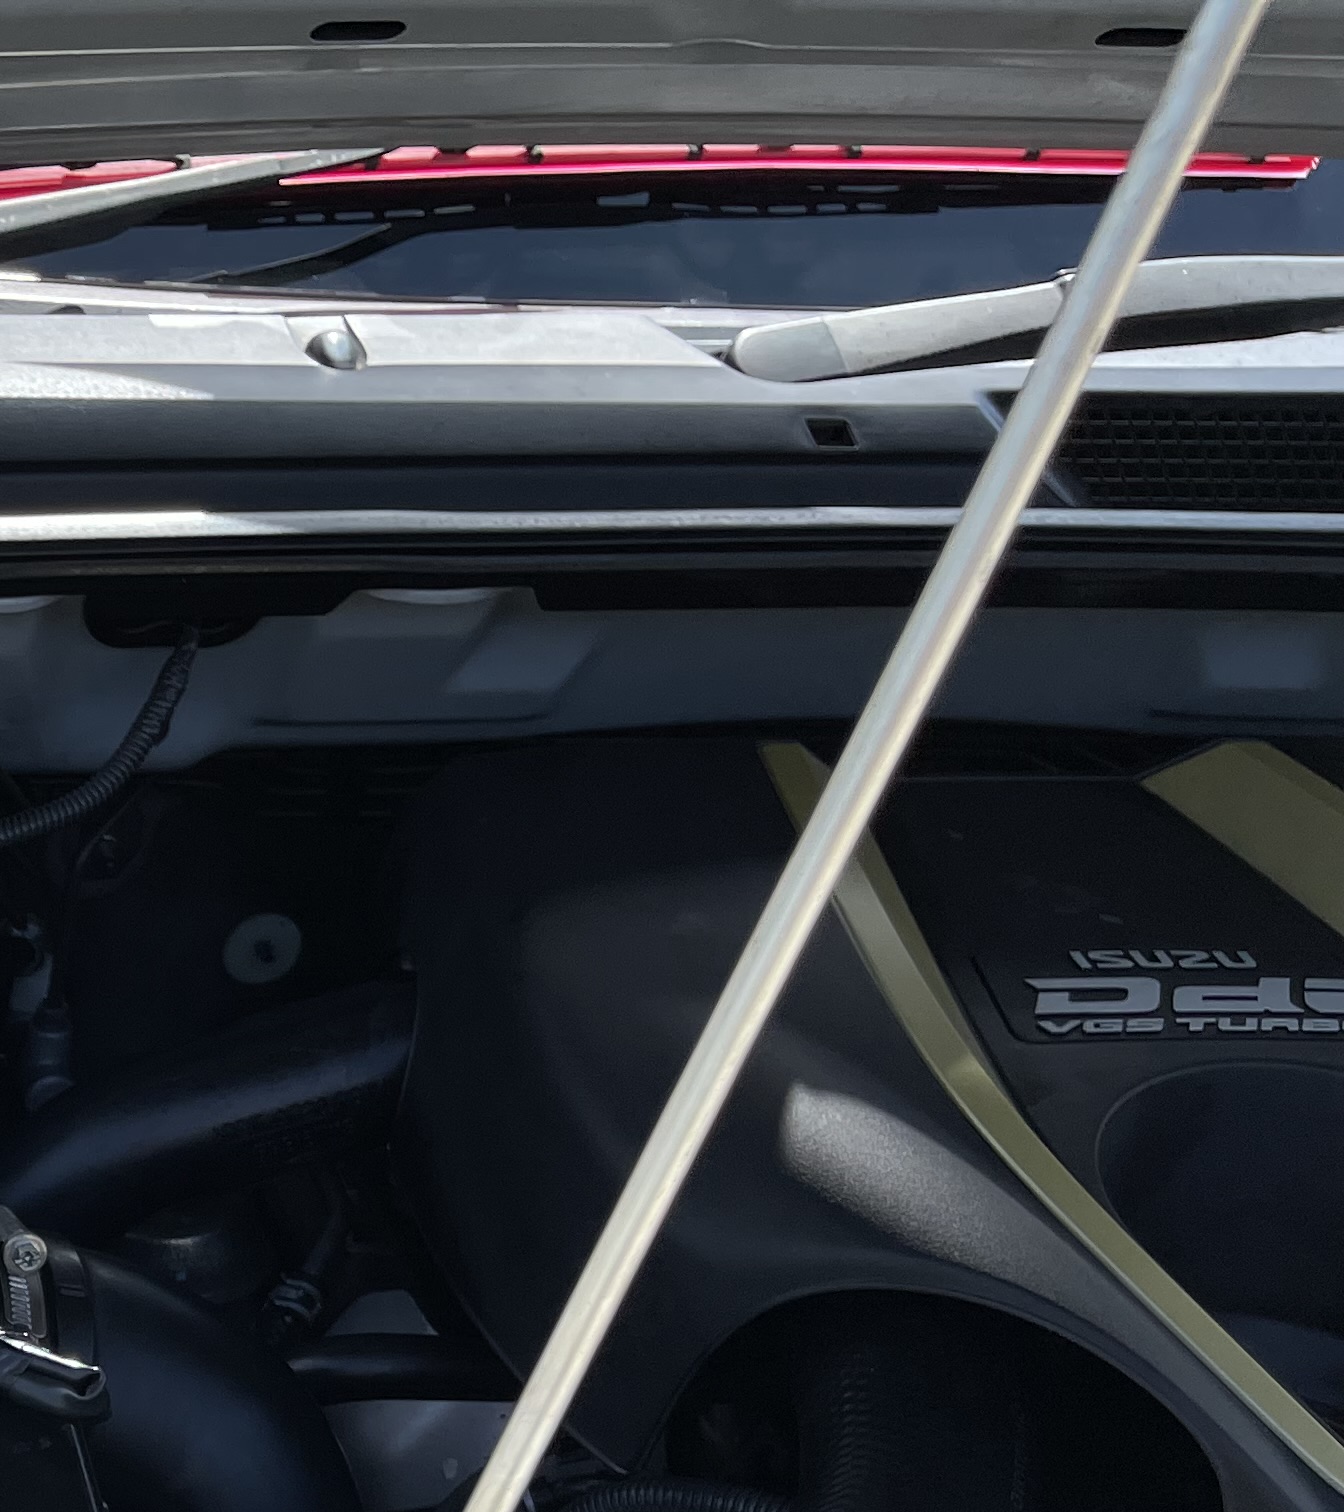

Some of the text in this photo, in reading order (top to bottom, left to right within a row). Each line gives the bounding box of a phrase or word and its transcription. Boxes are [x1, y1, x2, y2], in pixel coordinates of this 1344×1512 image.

[1069, 949, 1257, 970] ISUZU
[1037, 1017, 1344, 1035] VGS TURB
